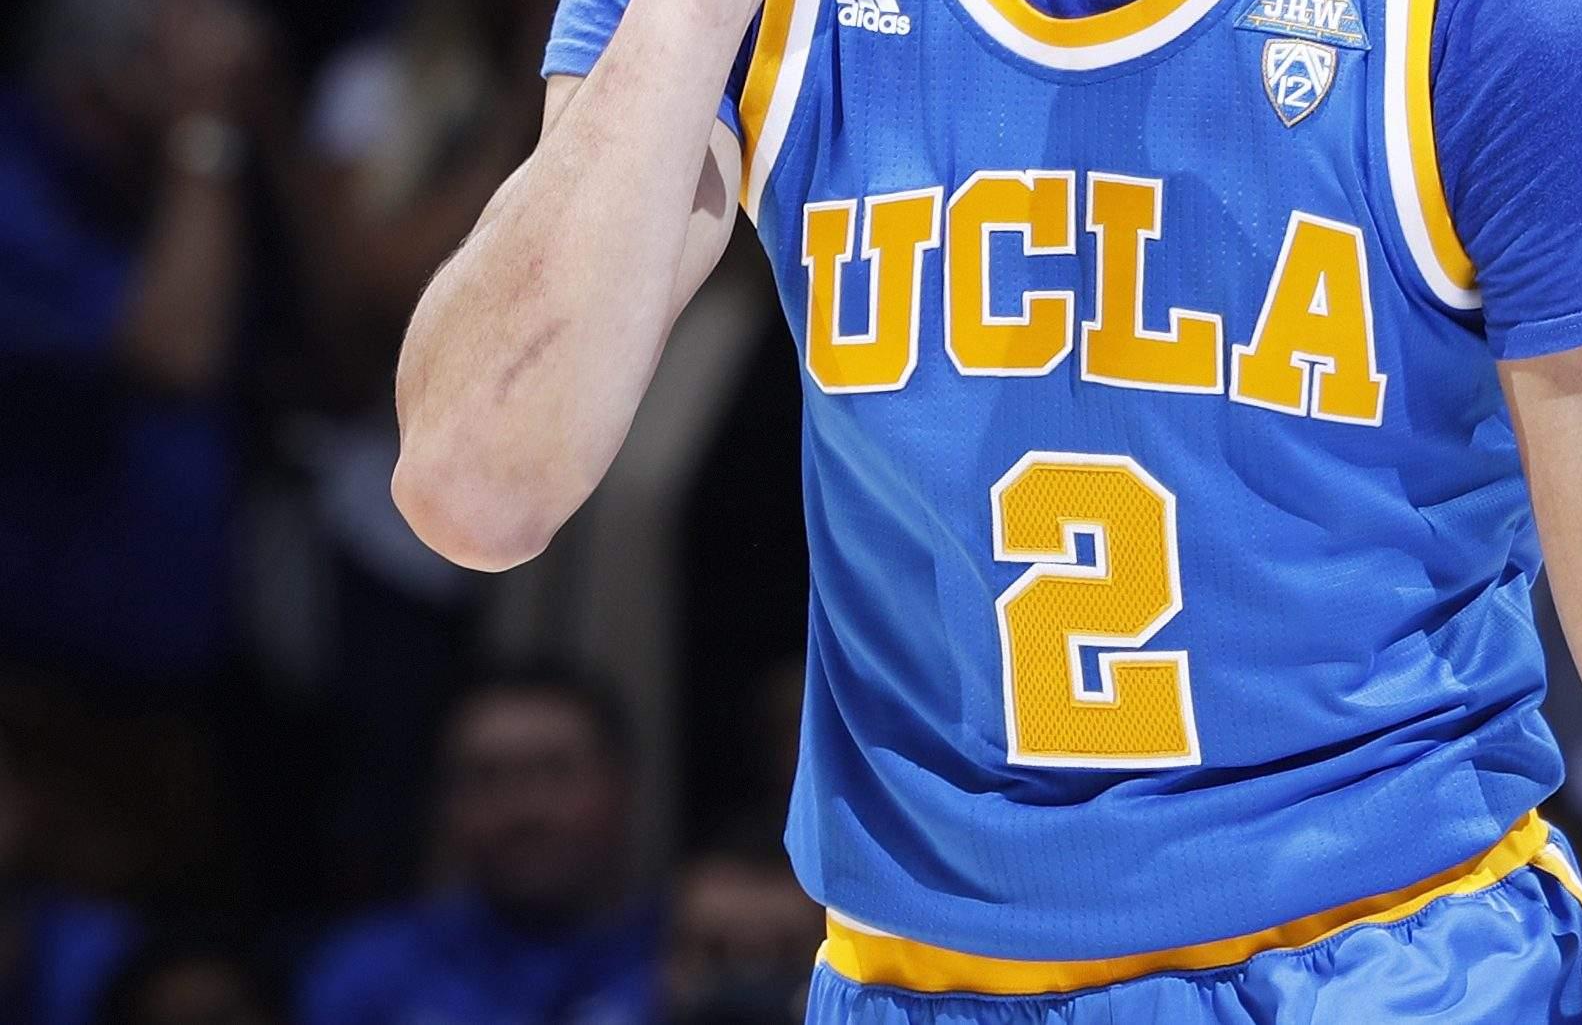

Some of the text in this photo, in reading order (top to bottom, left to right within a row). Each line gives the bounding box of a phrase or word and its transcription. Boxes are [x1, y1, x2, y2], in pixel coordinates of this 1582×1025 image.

[838, 1, 911, 35] adidas
[1266, 40, 1331, 94] PAC
[1277, 75, 1312, 108] 12
[802, 169, 1387, 427] UCLA
[990, 450, 1201, 769] 2
